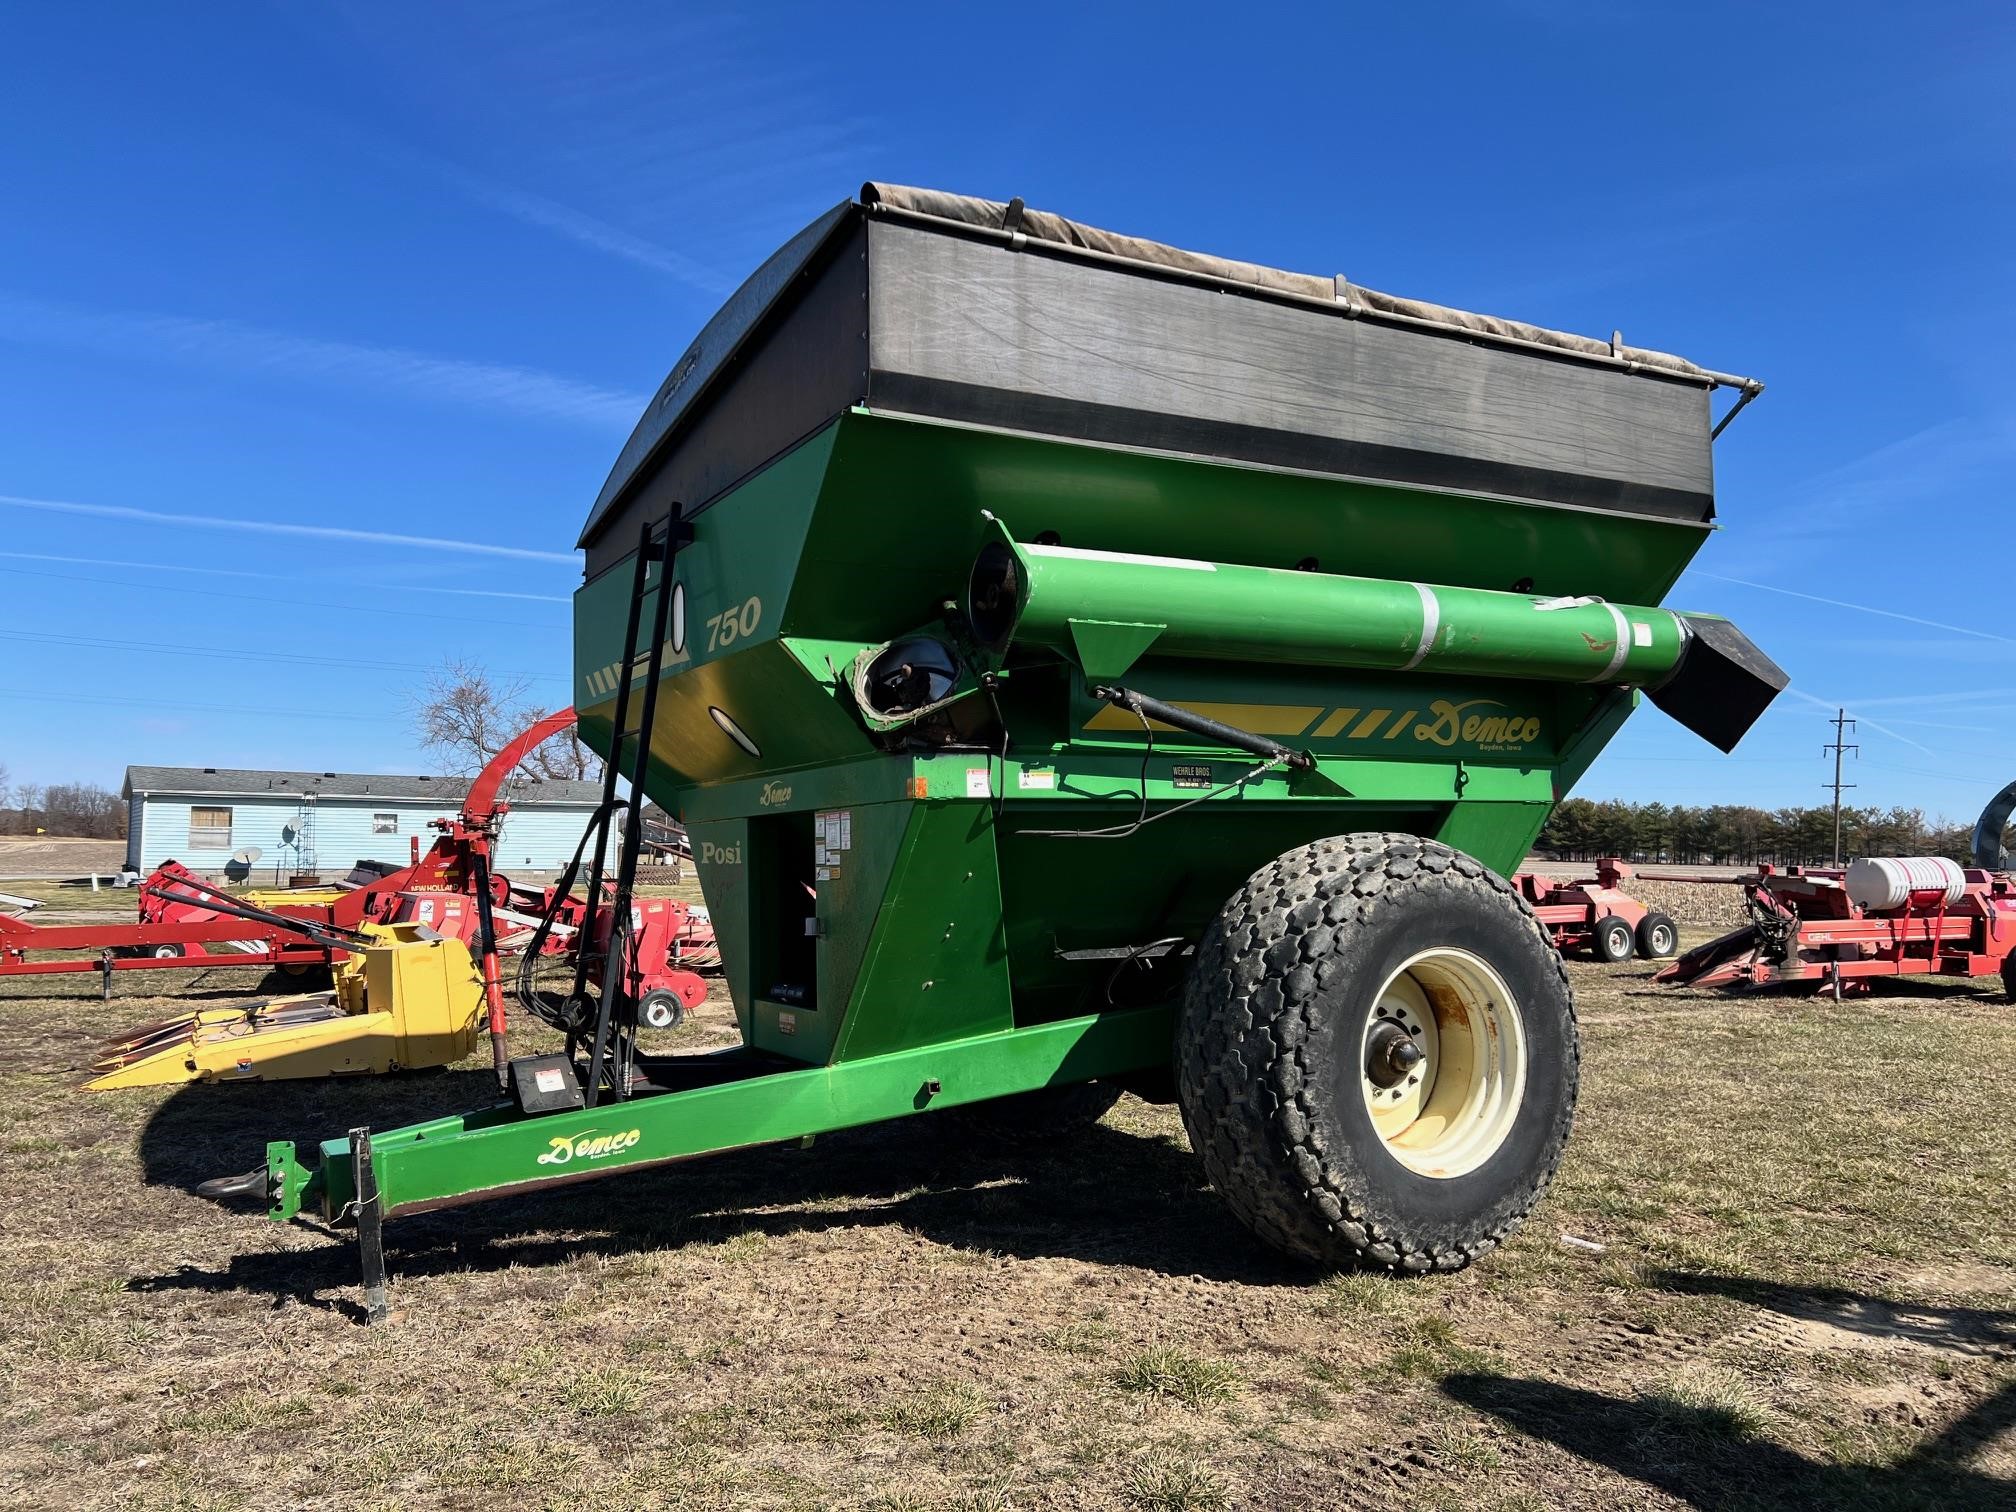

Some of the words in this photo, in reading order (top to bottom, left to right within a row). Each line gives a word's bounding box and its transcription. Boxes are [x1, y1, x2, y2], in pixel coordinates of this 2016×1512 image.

[706, 596, 762, 652] 750
[1414, 699, 1541, 746] Demco
[1506, 743, 1522, 751] Iowa
[1173, 766, 1195, 776] WEHRLE
[760, 780, 792, 806] Demco
[701, 840, 742, 865] Posi
[426, 883, 459, 892] HOLLAND
[537, 1128, 641, 1165] Demco
